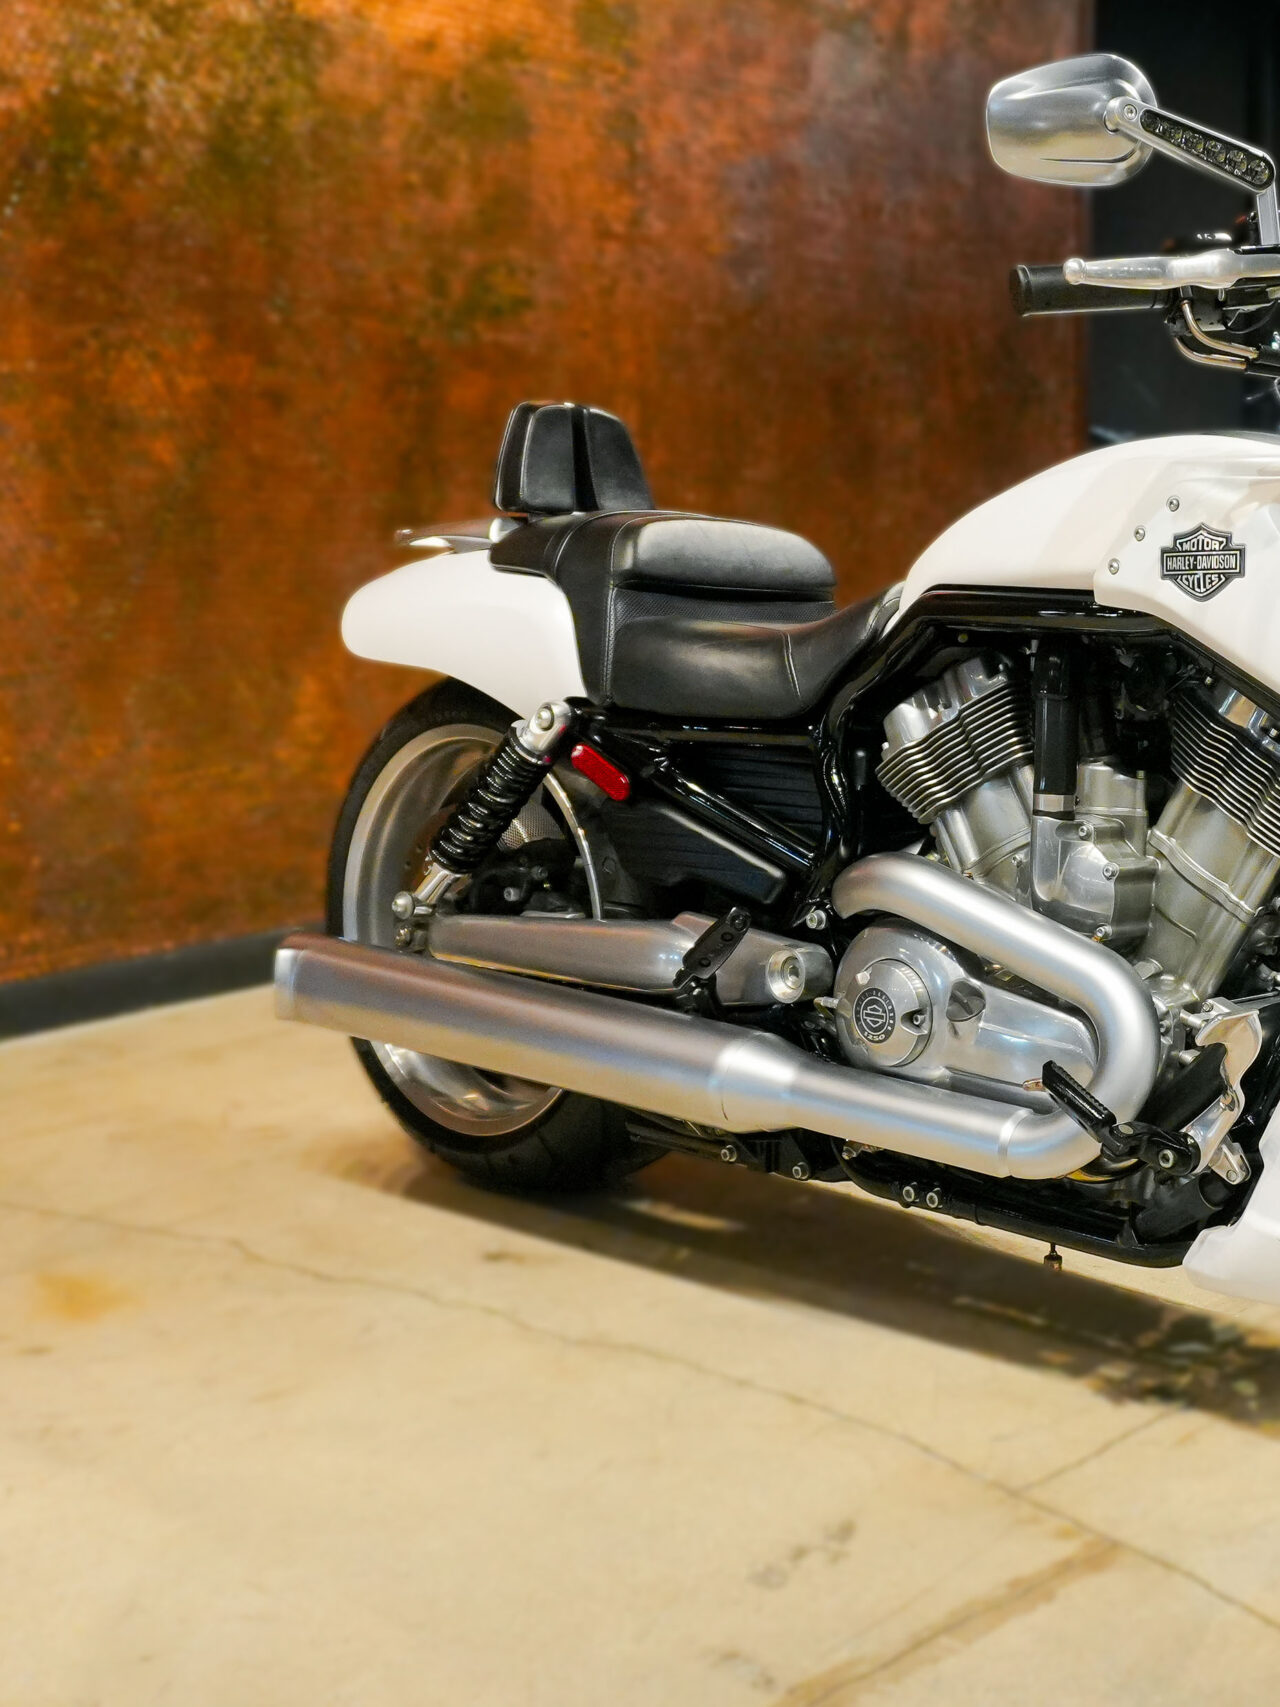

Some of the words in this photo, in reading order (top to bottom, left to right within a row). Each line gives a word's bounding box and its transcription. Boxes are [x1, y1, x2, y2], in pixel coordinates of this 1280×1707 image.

[1182, 536, 1219, 550] MOTOR
[1167, 554, 1236, 571] HARLEY-DAVIDSON
[1182, 572, 1218, 593] CYCLES
[864, 1031, 886, 1041] 1250
